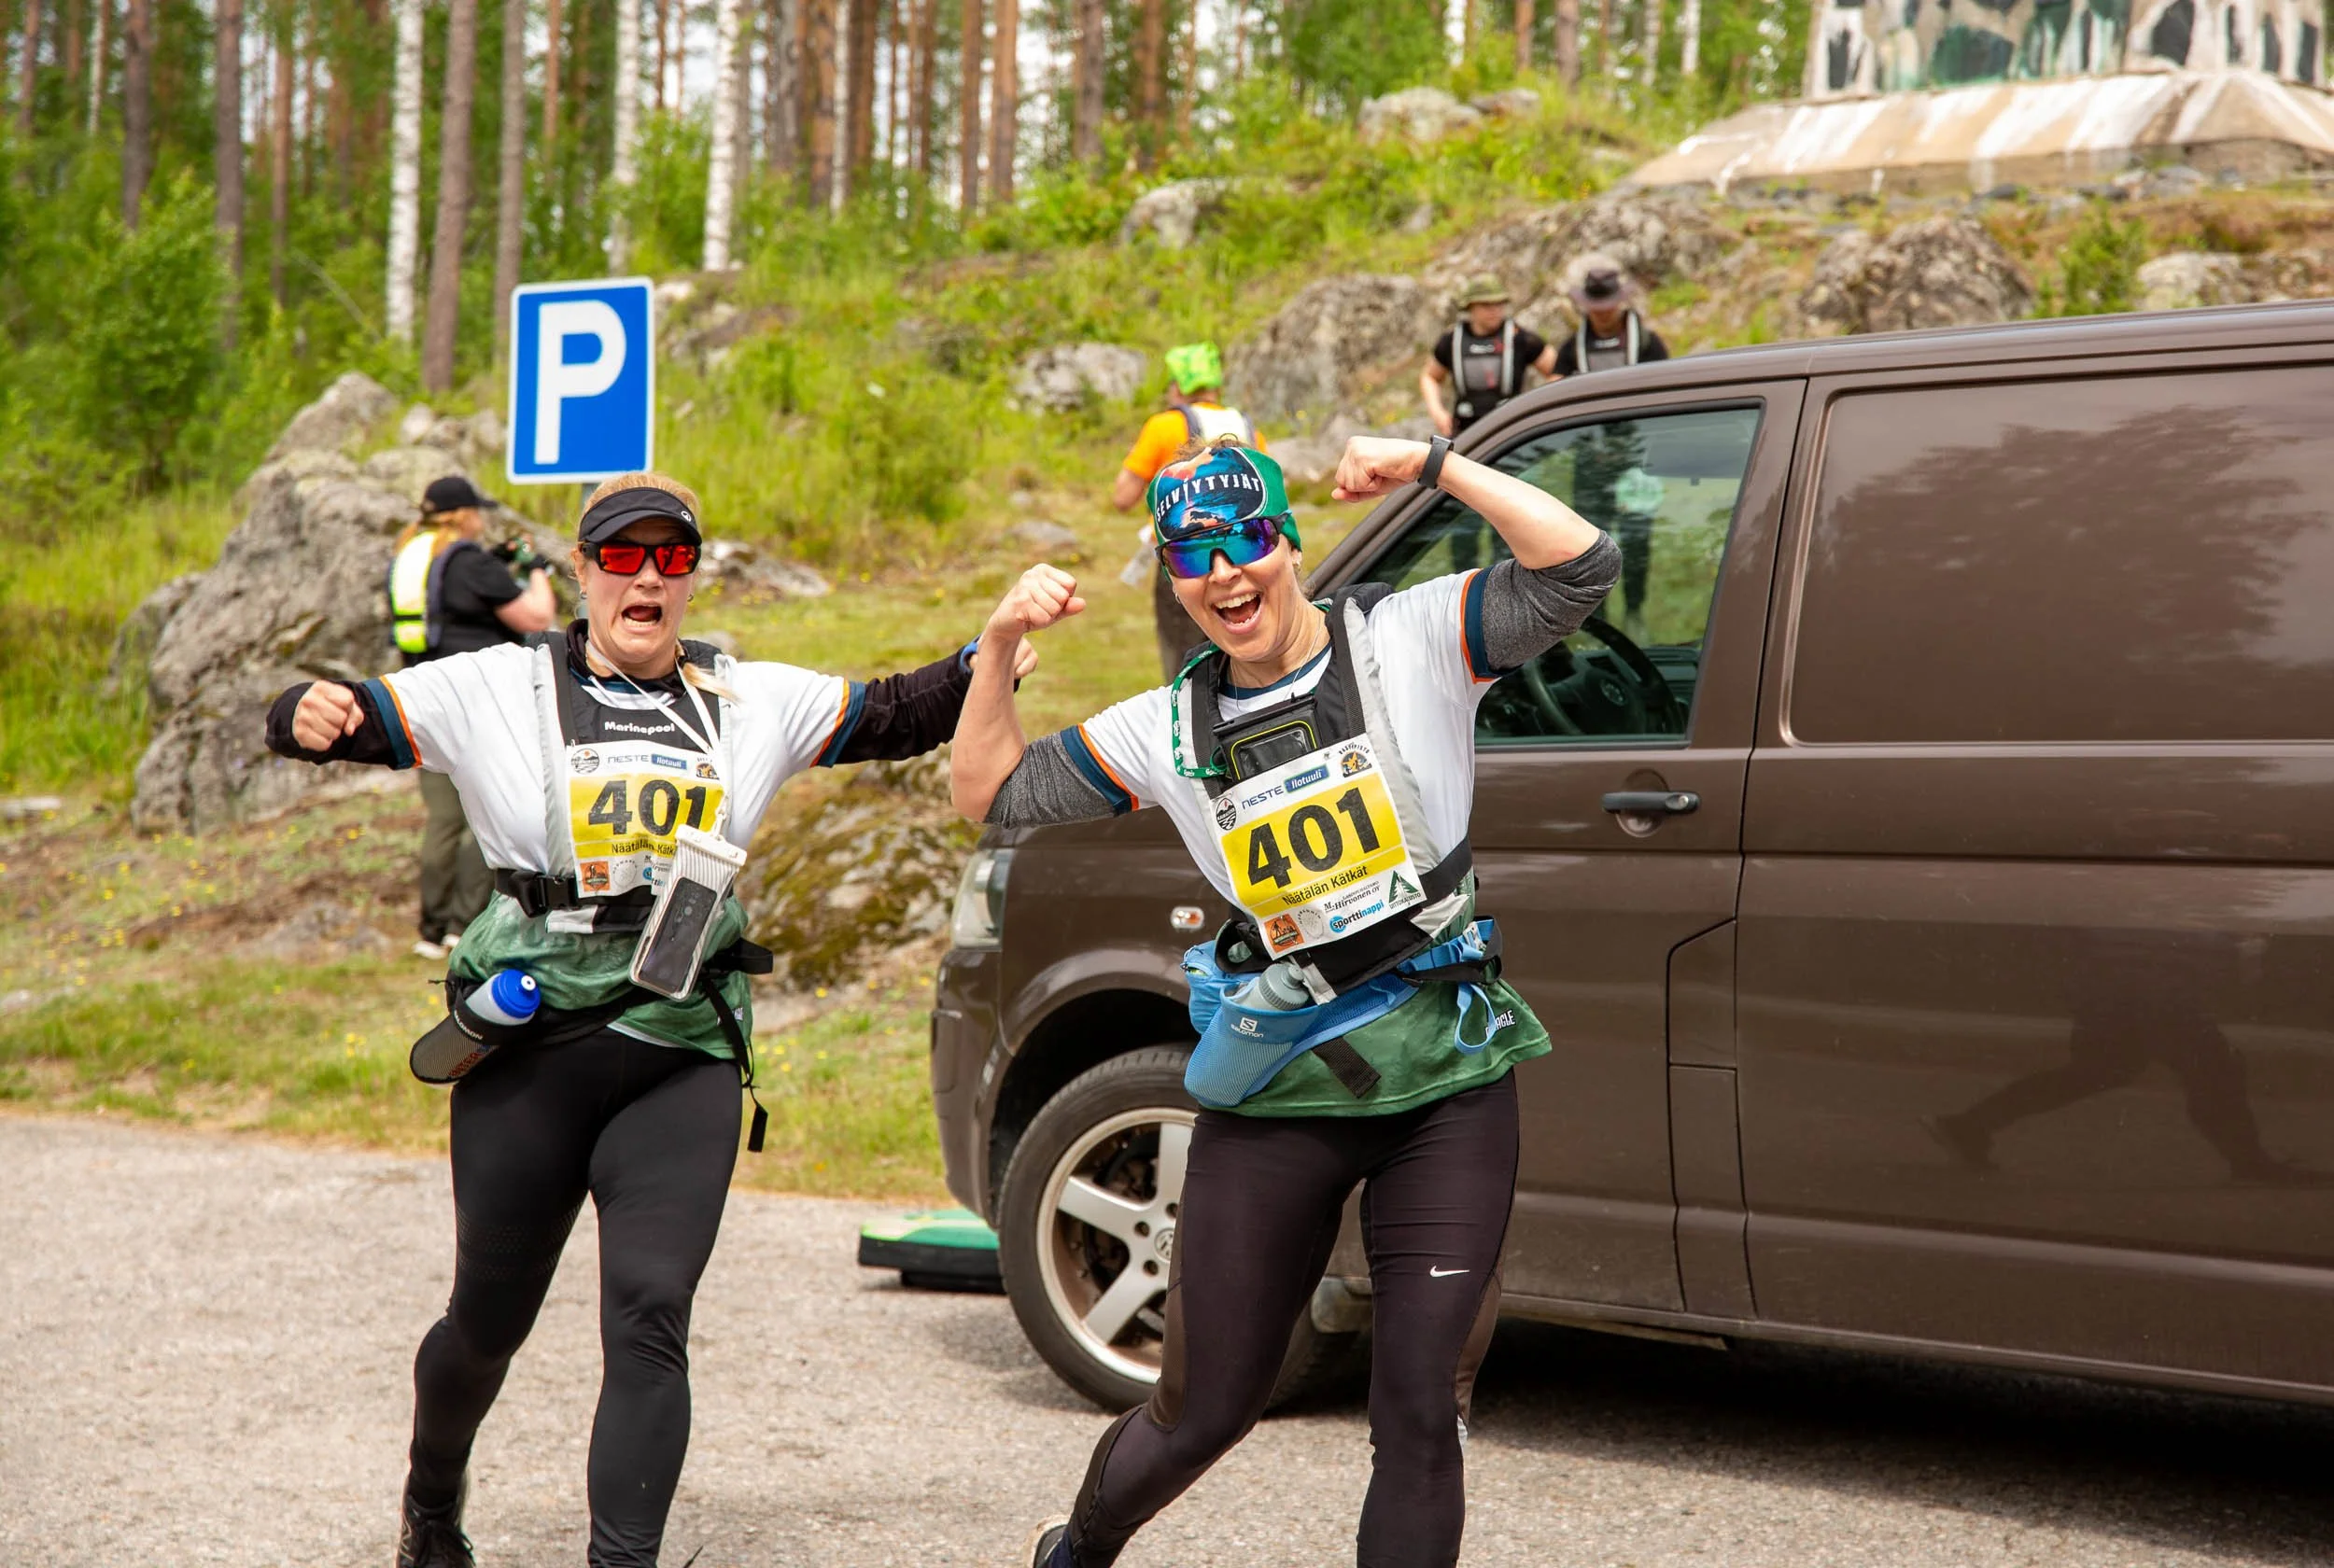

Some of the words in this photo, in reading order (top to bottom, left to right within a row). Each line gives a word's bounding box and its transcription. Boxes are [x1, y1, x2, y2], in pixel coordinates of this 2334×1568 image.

[533, 299, 627, 465] P
[1157, 473, 1260, 523] SELVIYTYJÄT
[608, 754, 649, 763] NESTE
[588, 779, 707, 836] 401
[1242, 785, 1284, 810] NESTE
[1247, 787, 1380, 889] 401
[1283, 882, 1329, 906] Näätälän
[1330, 865, 1368, 889] Kätkät
[1332, 899, 1385, 930] sporttinappi
